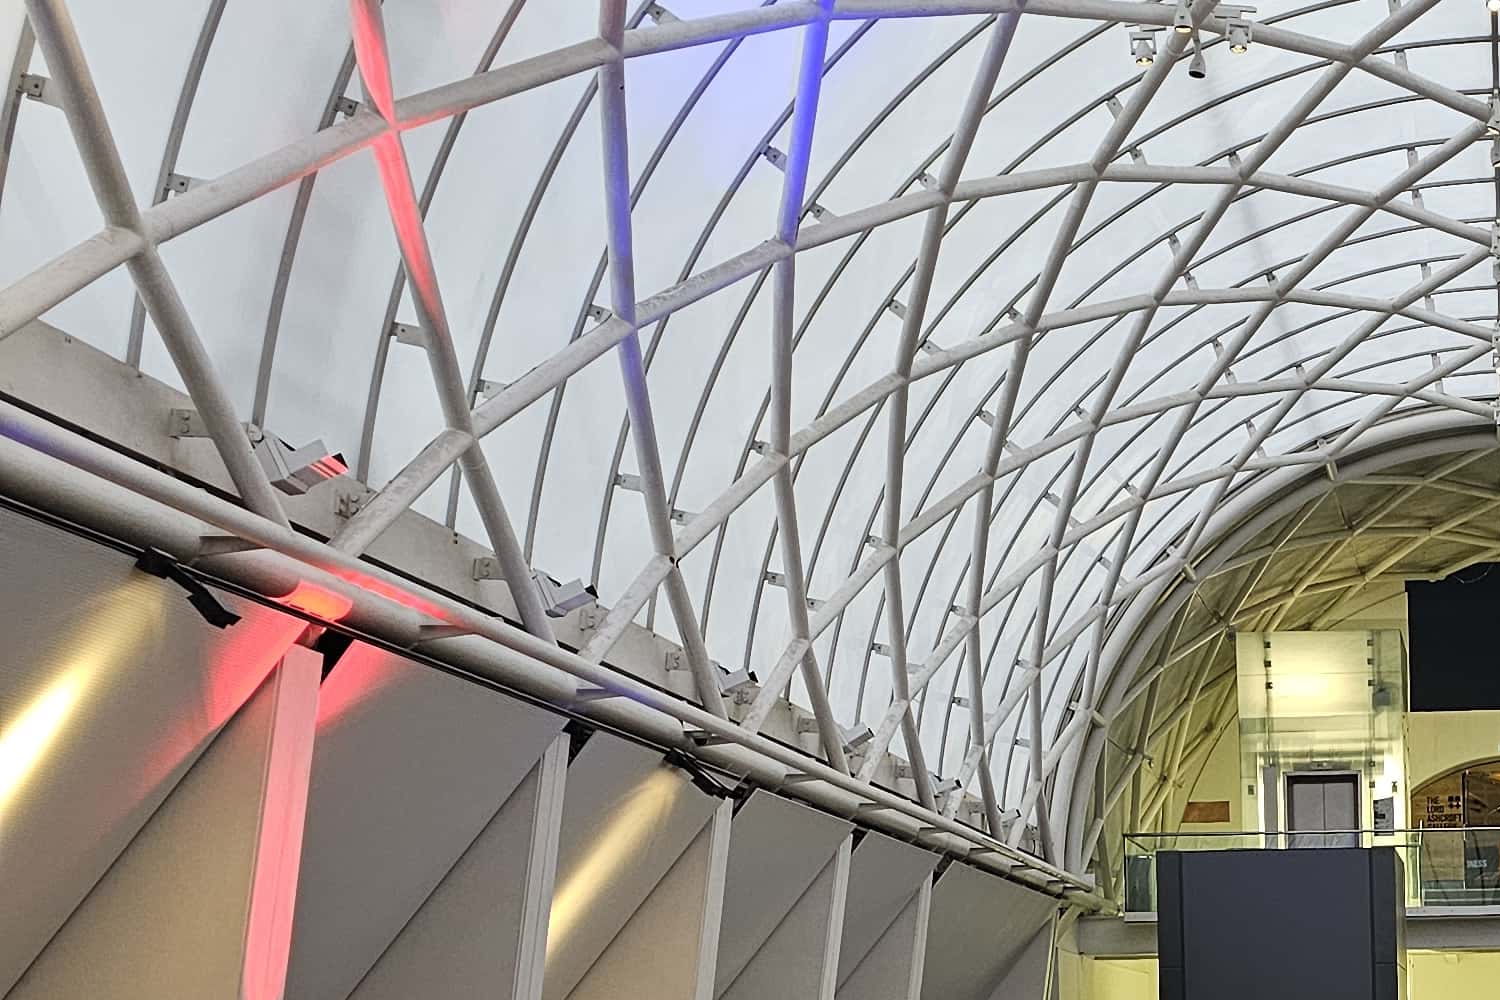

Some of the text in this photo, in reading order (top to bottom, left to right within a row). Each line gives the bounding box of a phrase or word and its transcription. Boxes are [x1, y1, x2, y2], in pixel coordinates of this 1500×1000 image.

[1427, 796, 1440, 805] THE
[1427, 805, 1444, 813] LORD
[1427, 814, 1462, 822] ASHCROFT
